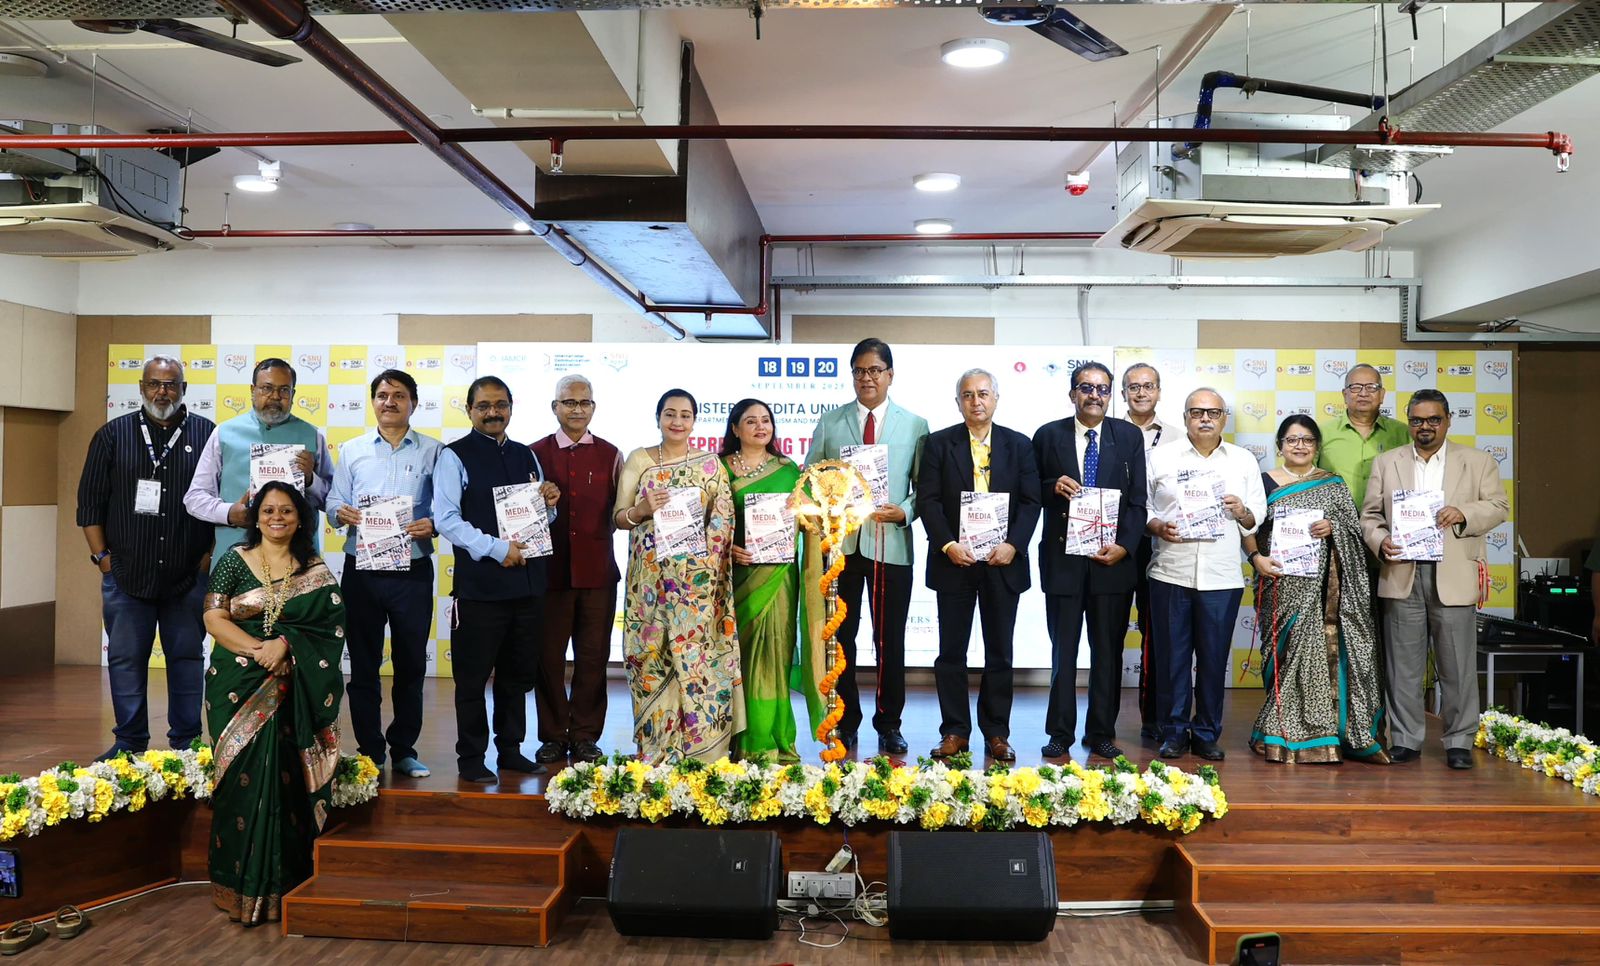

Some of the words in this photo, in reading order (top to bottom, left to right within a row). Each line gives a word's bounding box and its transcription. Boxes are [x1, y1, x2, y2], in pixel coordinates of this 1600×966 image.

[763, 361, 777, 373] 18
[791, 361, 805, 374] 19
[817, 361, 834, 373] 20
[751, 382, 816, 390] SEPTEMBER
[699, 402, 736, 414] ISTER
[767, 403, 806, 414] EDITA
